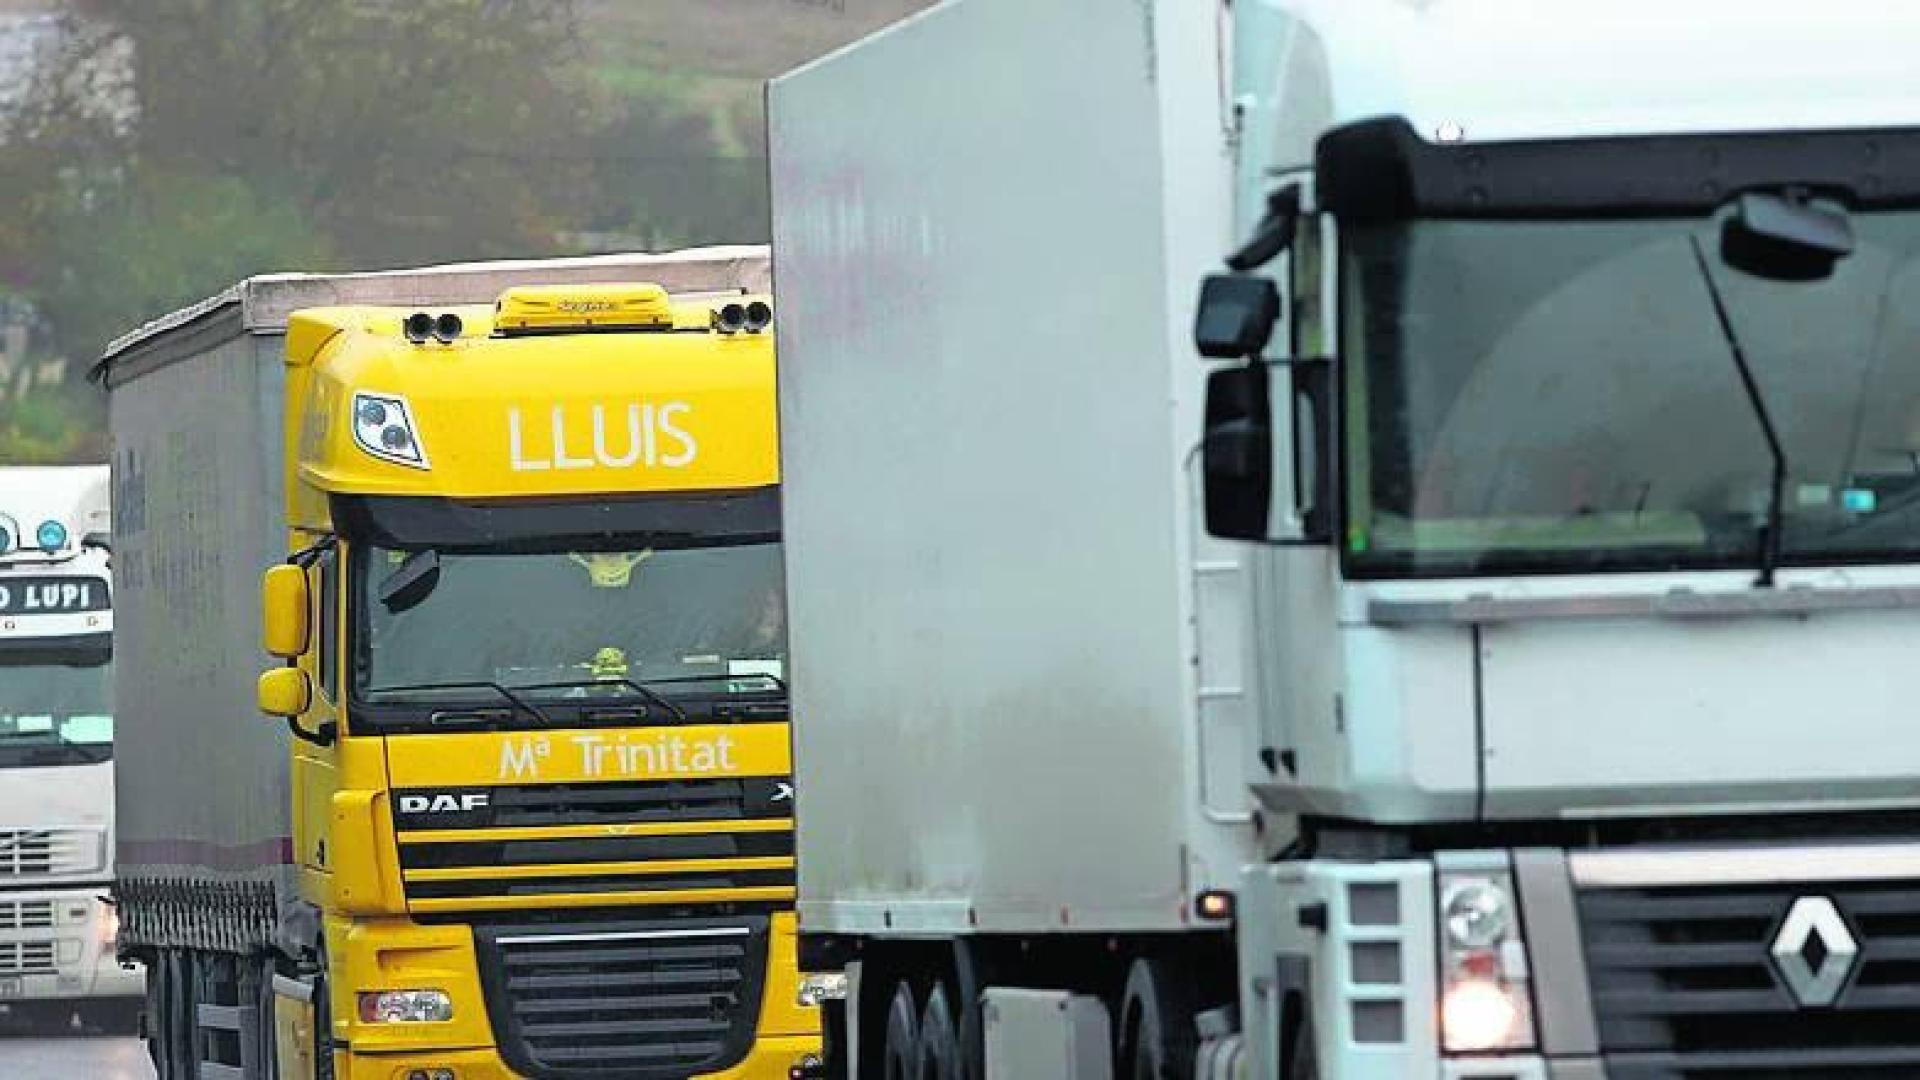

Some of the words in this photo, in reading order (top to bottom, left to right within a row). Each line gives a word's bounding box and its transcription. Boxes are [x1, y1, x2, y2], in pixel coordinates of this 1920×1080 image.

[509, 401, 698, 470] LLUIS
[25, 584, 89, 609] LUPI
[571, 734, 738, 777] Trinitat
[400, 794, 489, 813] DAF
